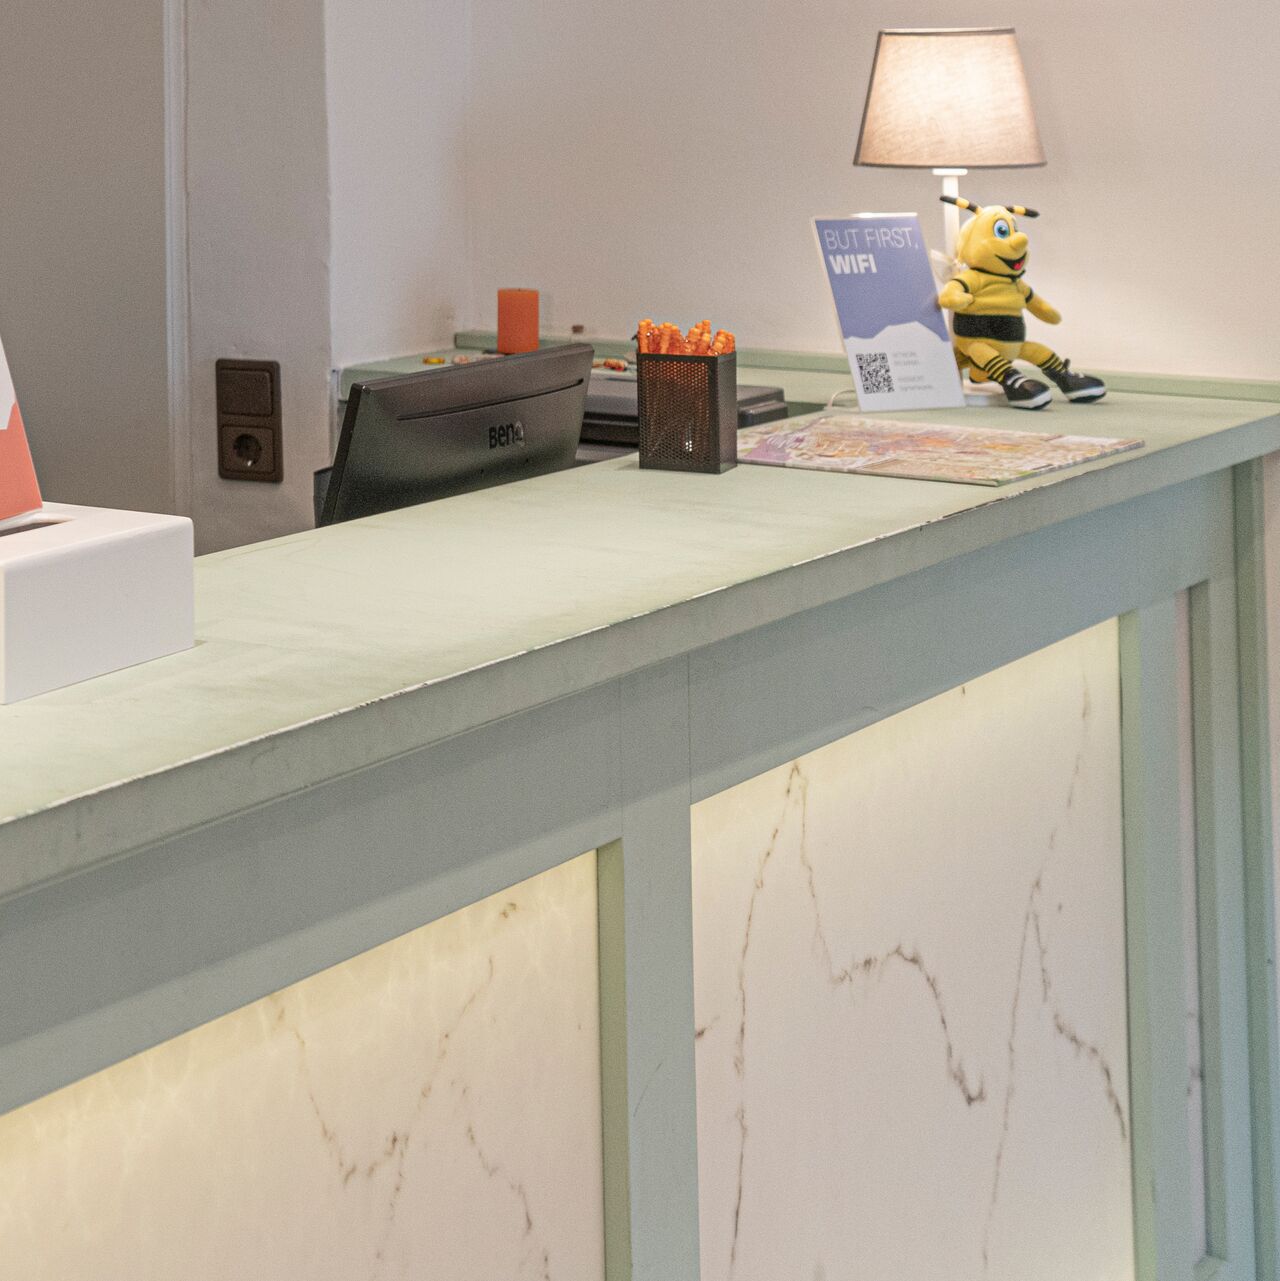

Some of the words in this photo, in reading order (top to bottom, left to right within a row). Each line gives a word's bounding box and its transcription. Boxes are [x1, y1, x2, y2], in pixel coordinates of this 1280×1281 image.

[824, 228, 859, 250] BUT
[864, 227, 919, 250] FIRST,
[829, 253, 877, 274] WIFI
